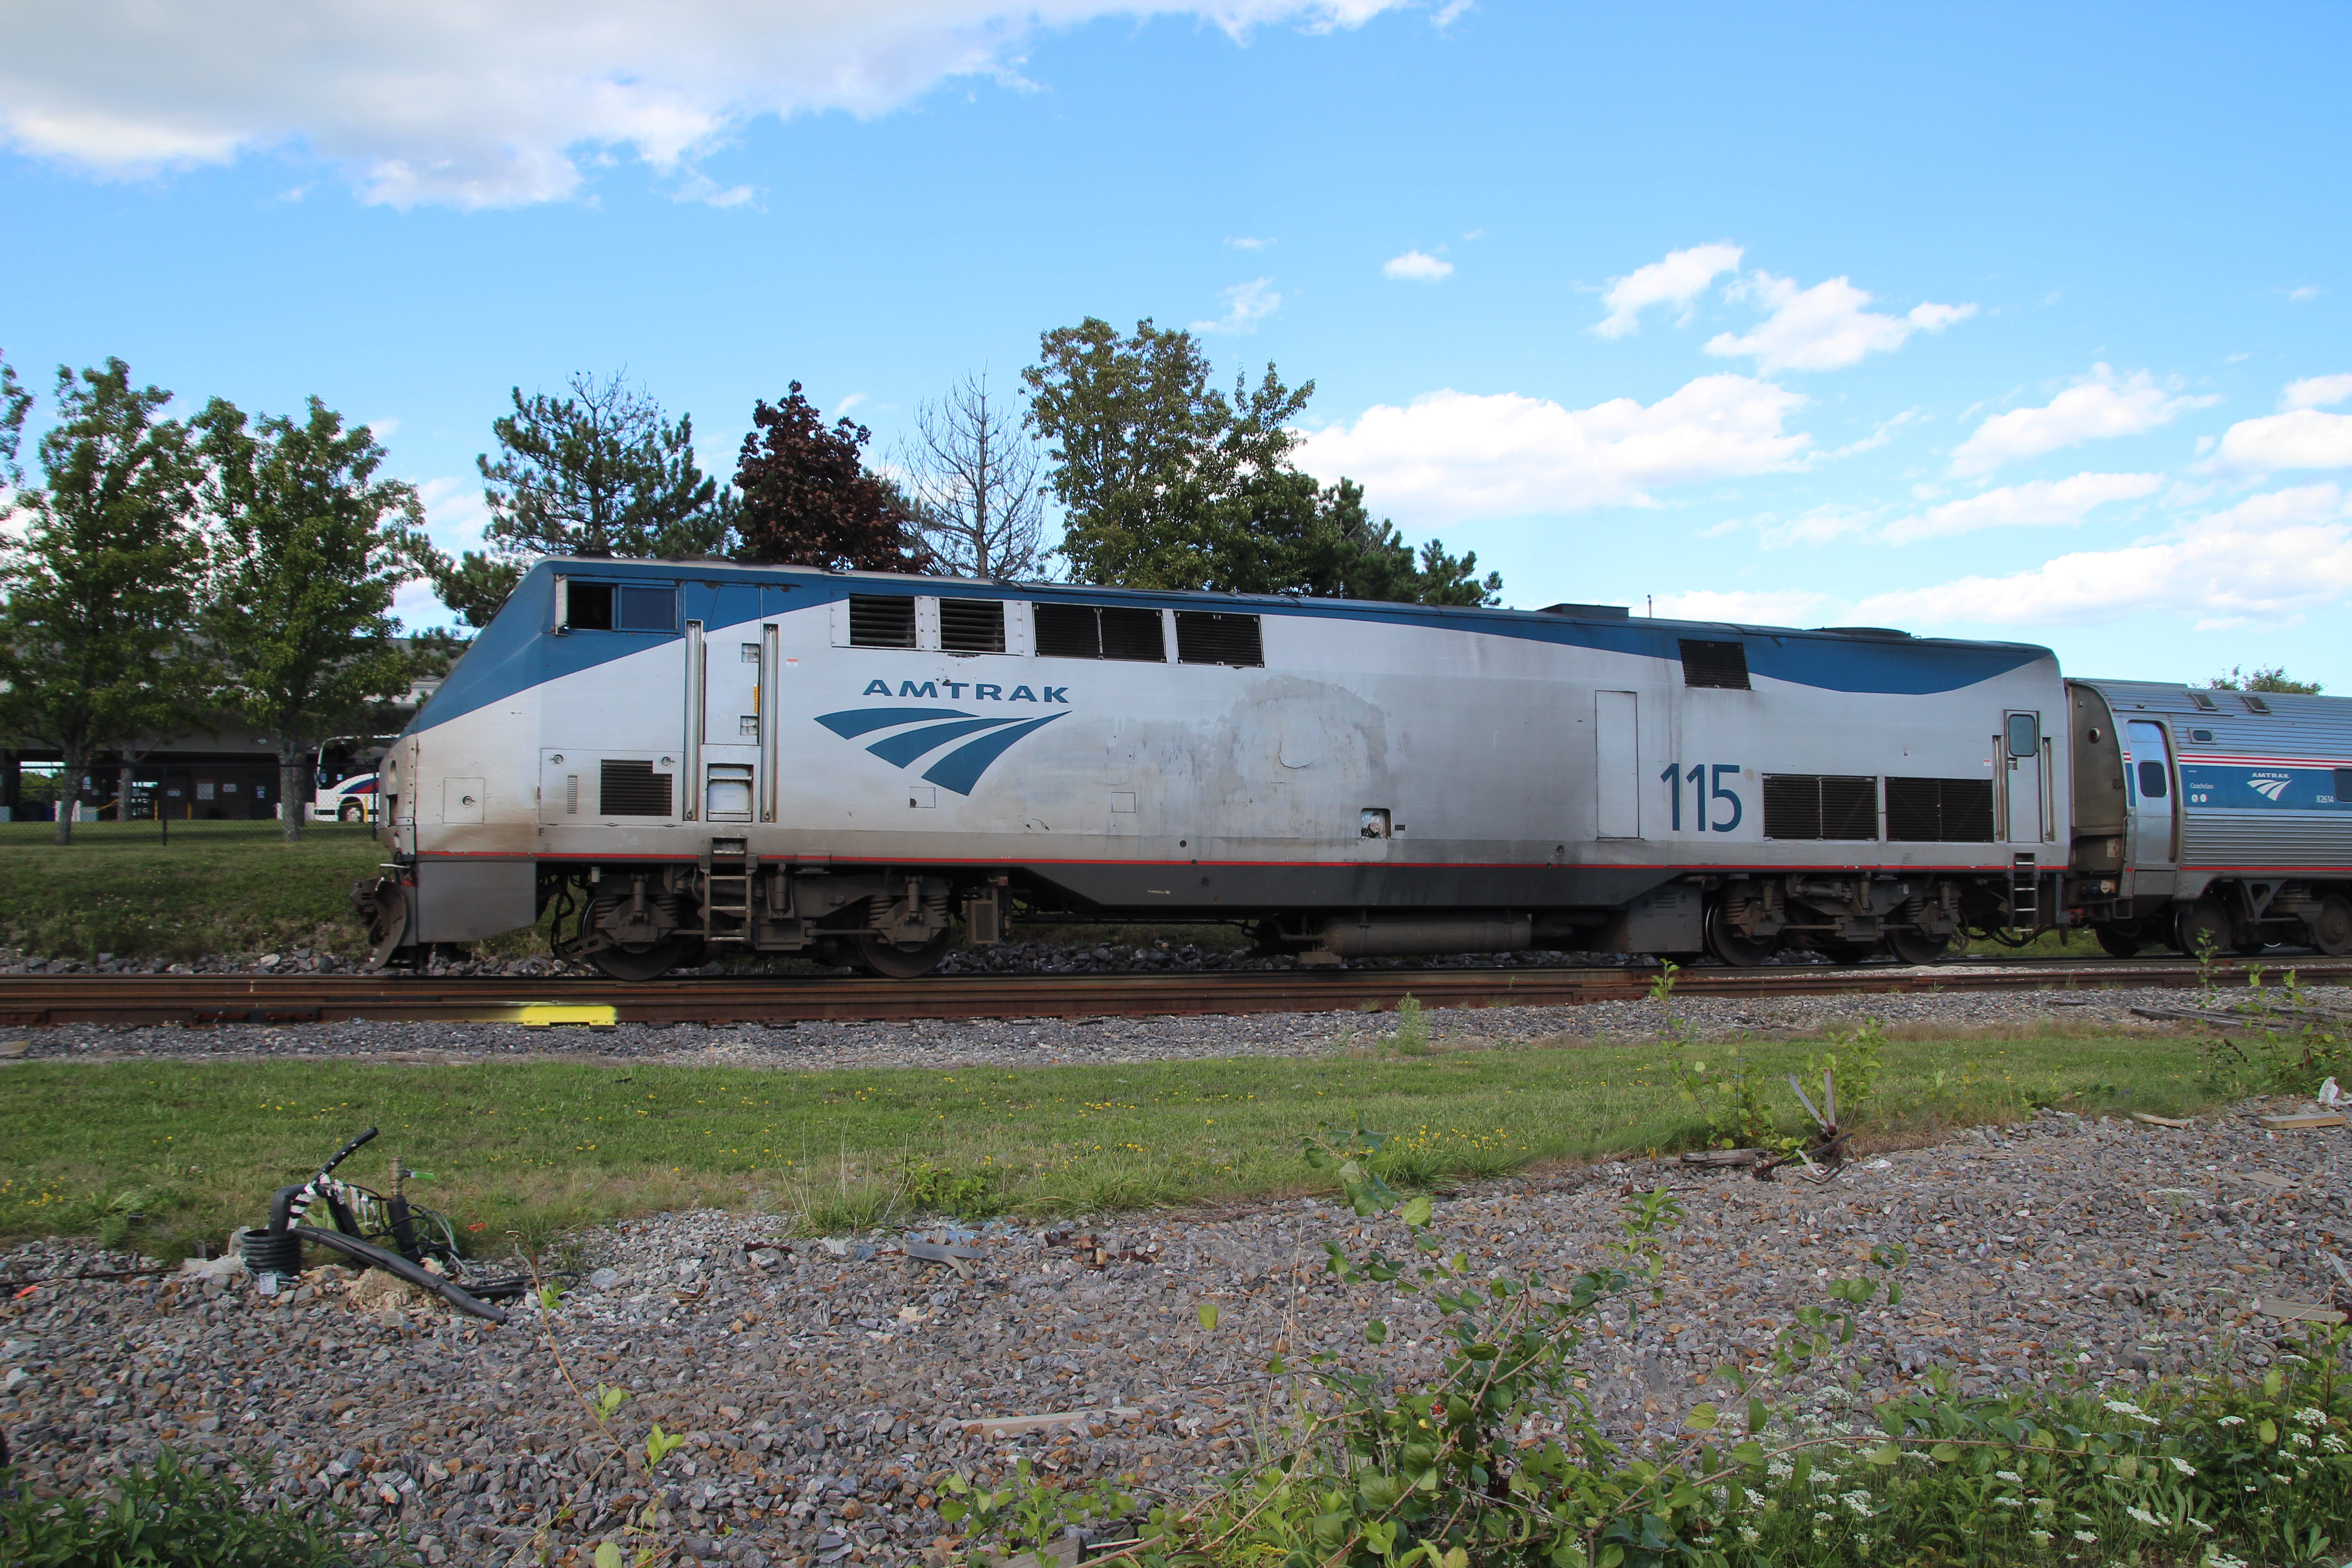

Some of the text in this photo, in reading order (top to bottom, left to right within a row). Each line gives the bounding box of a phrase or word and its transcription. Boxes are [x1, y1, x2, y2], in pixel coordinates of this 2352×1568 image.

[862, 679, 1070, 703] AMTRAK
[1660, 763, 1742, 833] 115
[2316, 795, 2334, 803] 82614
[539, 828, 544, 837] F
